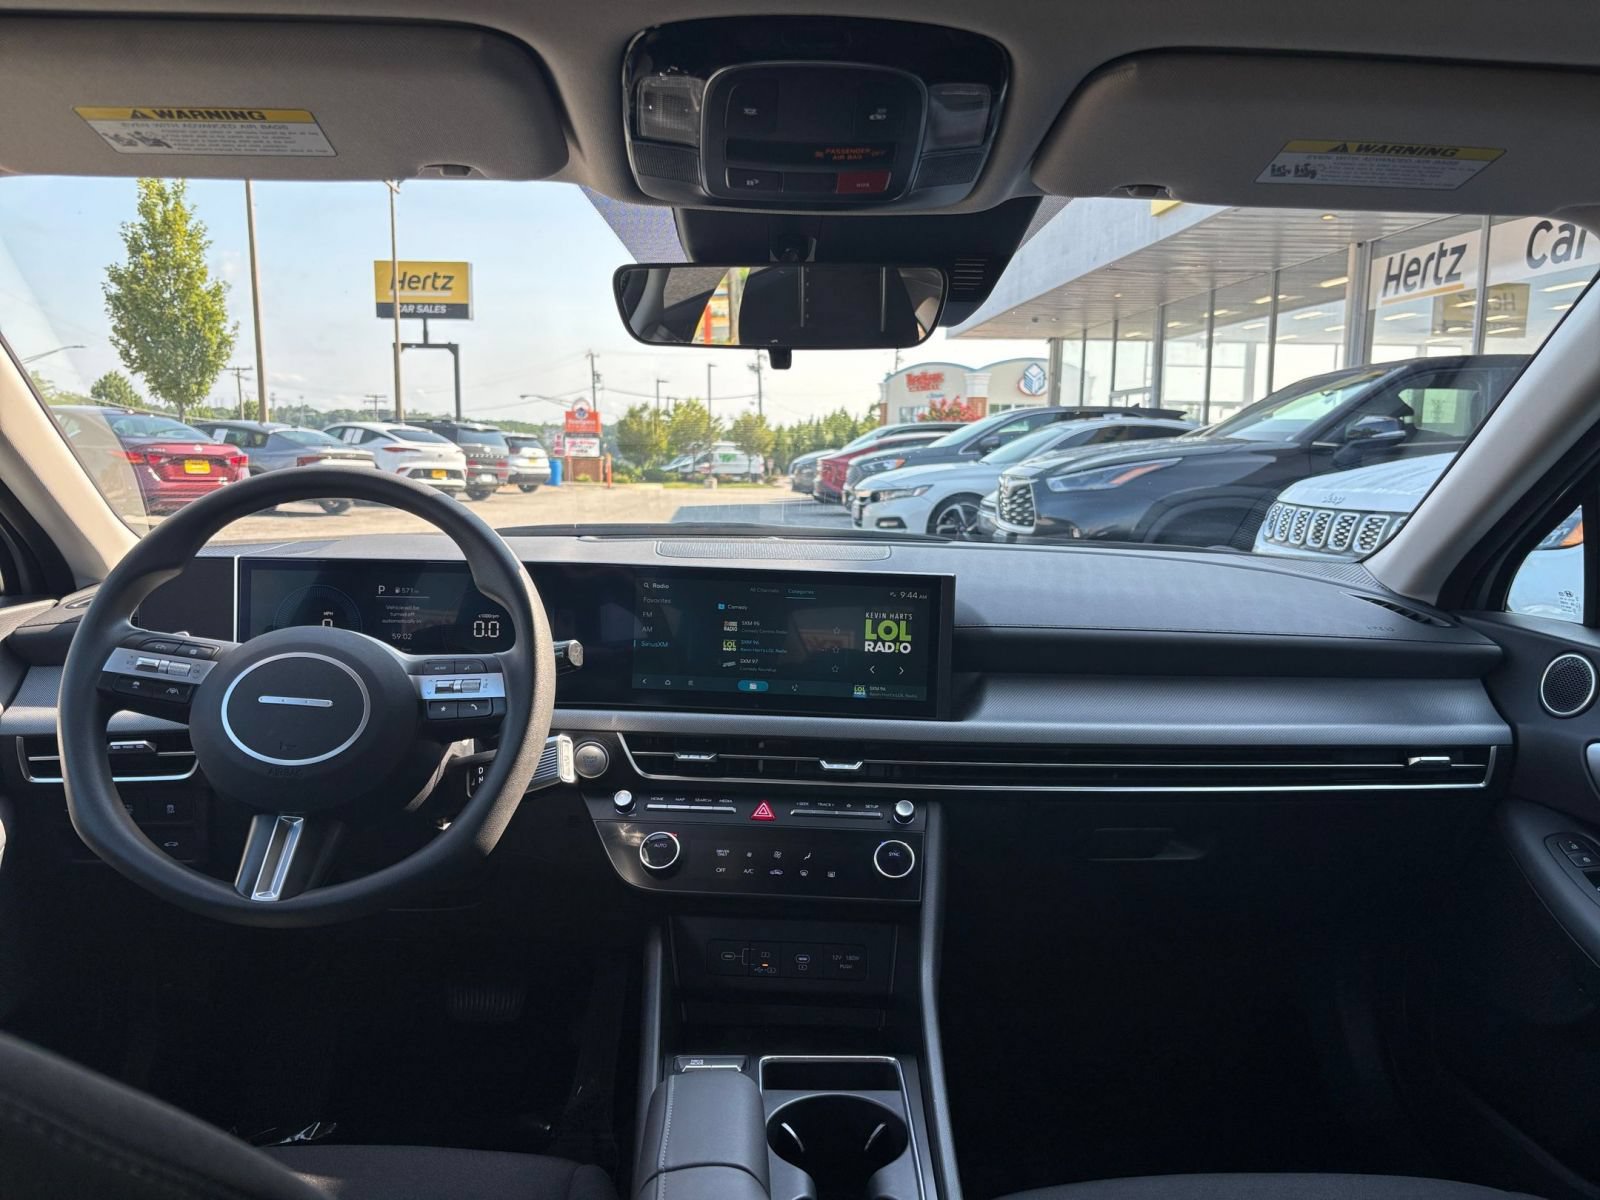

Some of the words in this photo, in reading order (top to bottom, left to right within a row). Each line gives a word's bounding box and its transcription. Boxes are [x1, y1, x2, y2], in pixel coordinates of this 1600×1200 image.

[151, 109, 267, 121] WARNING
[1355, 143, 1460, 157] WARNING
[1382, 241, 1468, 298] Hertz
[389, 271, 455, 291] Hertz
[415, 304, 447, 314] SALES
[378, 585, 386, 595] P
[900, 591, 918, 599] 9:44
[643, 596, 672, 604] Favorites
[473, 620, 500, 638] 0.0
[865, 619, 912, 641] LOL
[478, 766, 484, 775] D
